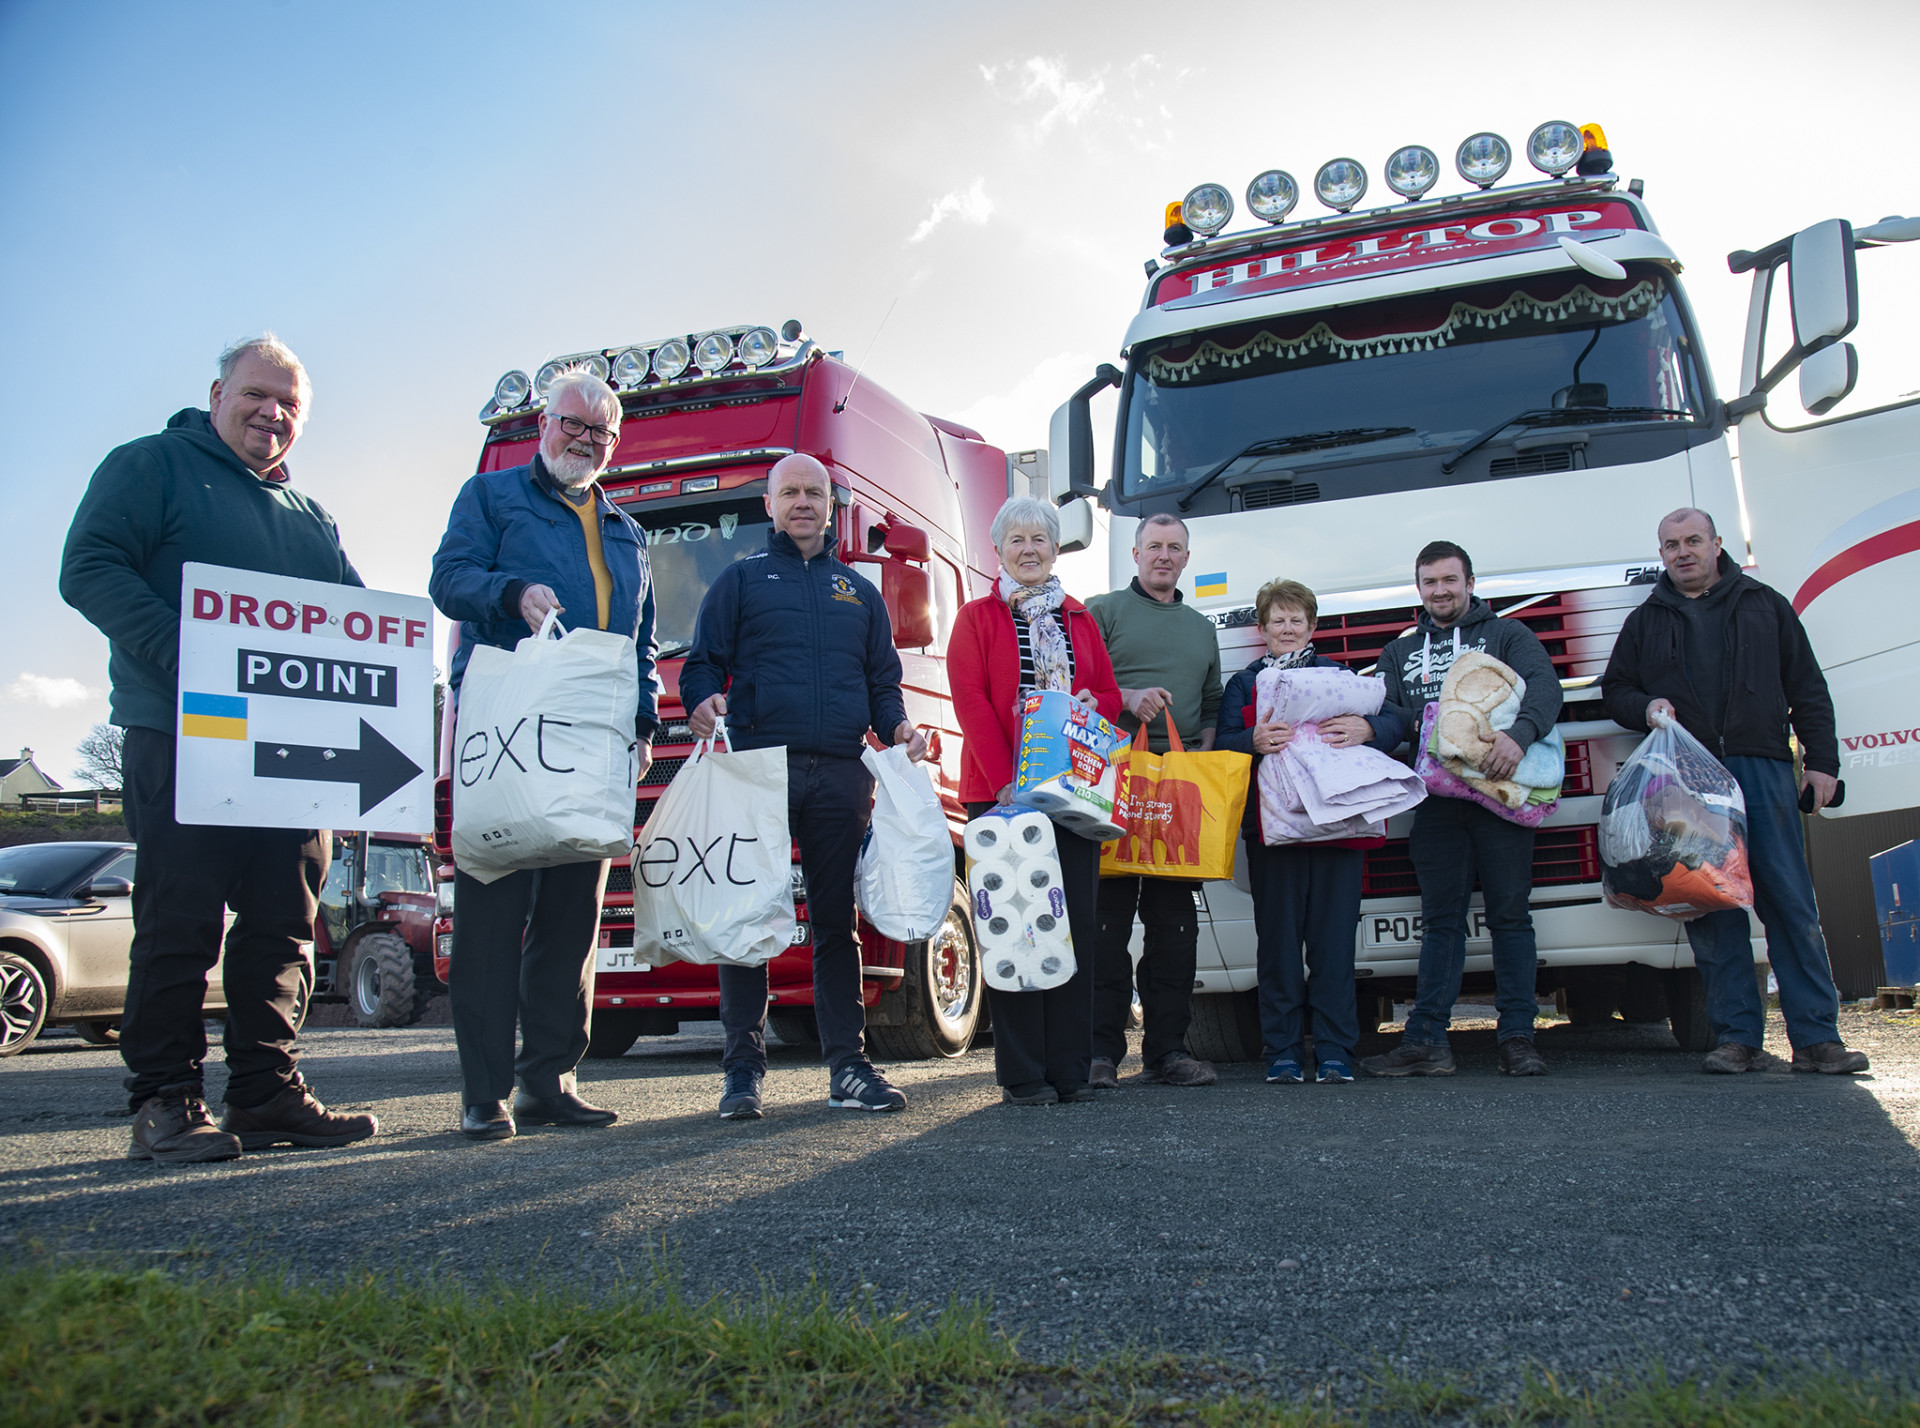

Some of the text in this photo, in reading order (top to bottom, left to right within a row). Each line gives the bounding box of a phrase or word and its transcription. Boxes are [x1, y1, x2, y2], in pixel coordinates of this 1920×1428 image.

[1186, 210, 1603, 296] HILLTOP
[1624, 566, 1660, 582] FH
[192, 587, 427, 648] DROP OFF
[247, 654, 386, 697] POINT
[1072, 749, 1102, 770] KITCHEN
[1077, 760, 1096, 776] ROLL
[1129, 794, 1172, 813] I'm strong
[1144, 809, 1173, 824] sturdy
[631, 832, 758, 889] next
